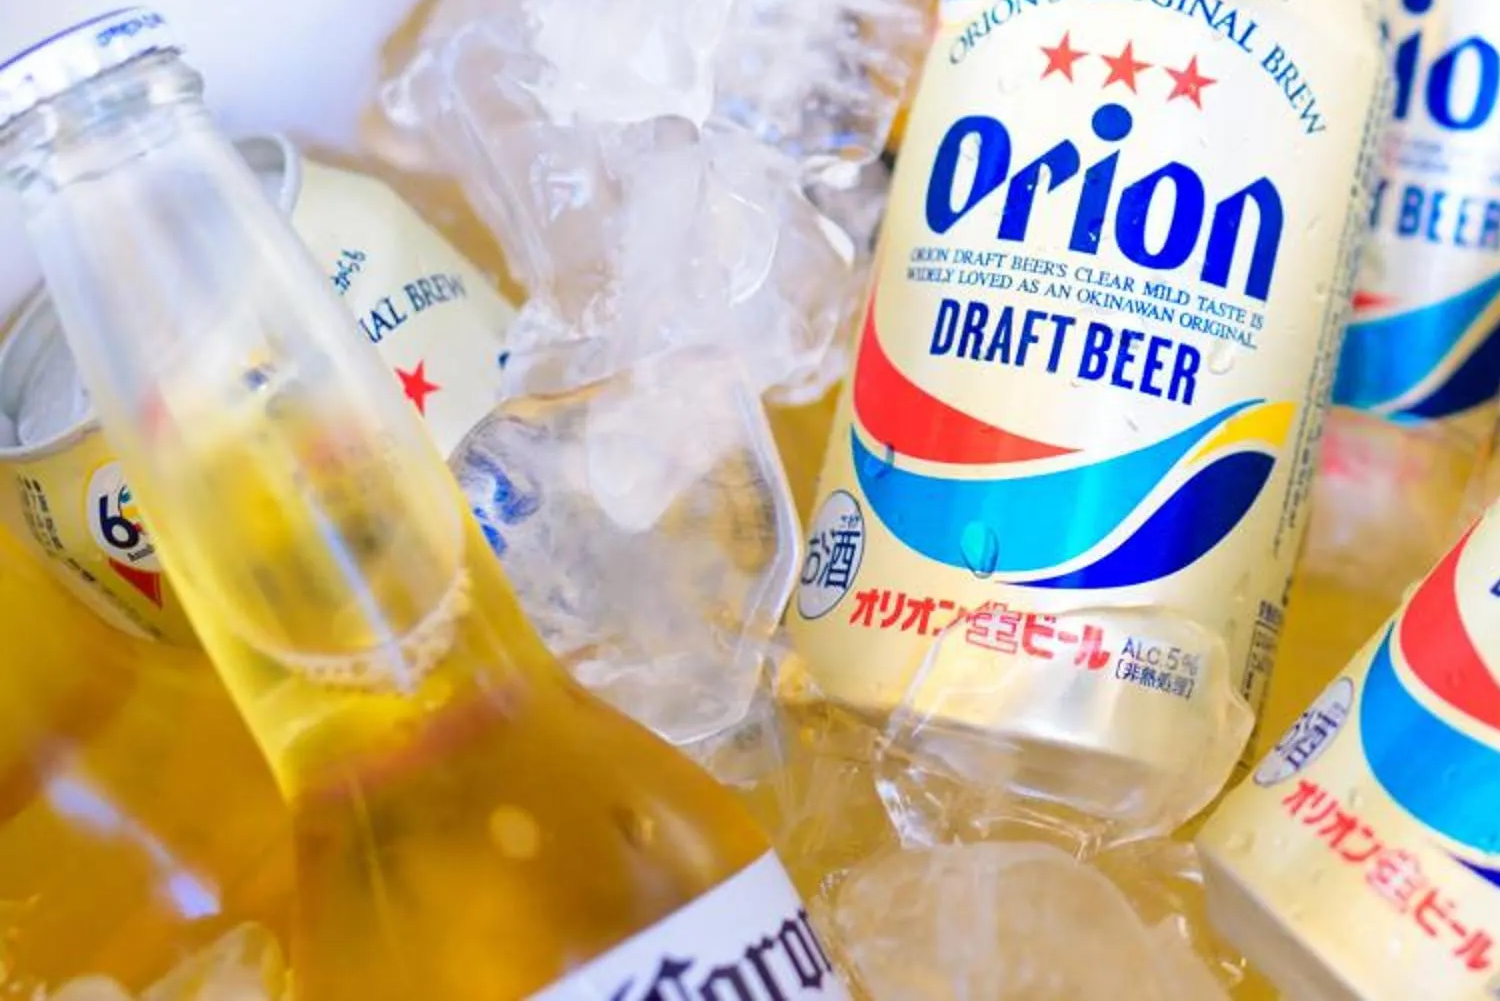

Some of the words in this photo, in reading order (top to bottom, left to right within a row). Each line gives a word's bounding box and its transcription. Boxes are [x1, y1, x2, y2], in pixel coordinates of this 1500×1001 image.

[1260, 44, 1327, 136] BREW
[952, 248, 1009, 269] DRAFT
[1010, 255, 1069, 278] BEER'S
[1074, 265, 1136, 293] CLEAR
[1142, 280, 1191, 306] MILD
[1197, 295, 1247, 325] TASTE
[1249, 312, 1265, 330] IS
[958, 269, 1013, 290] LOVED
[1017, 277, 1040, 294] AS
[1044, 283, 1073, 300] AN
[1076, 286, 1175, 324] OKINAWAN
[929, 297, 1077, 374] DRAFT
[1077, 320, 1201, 406] BEER
